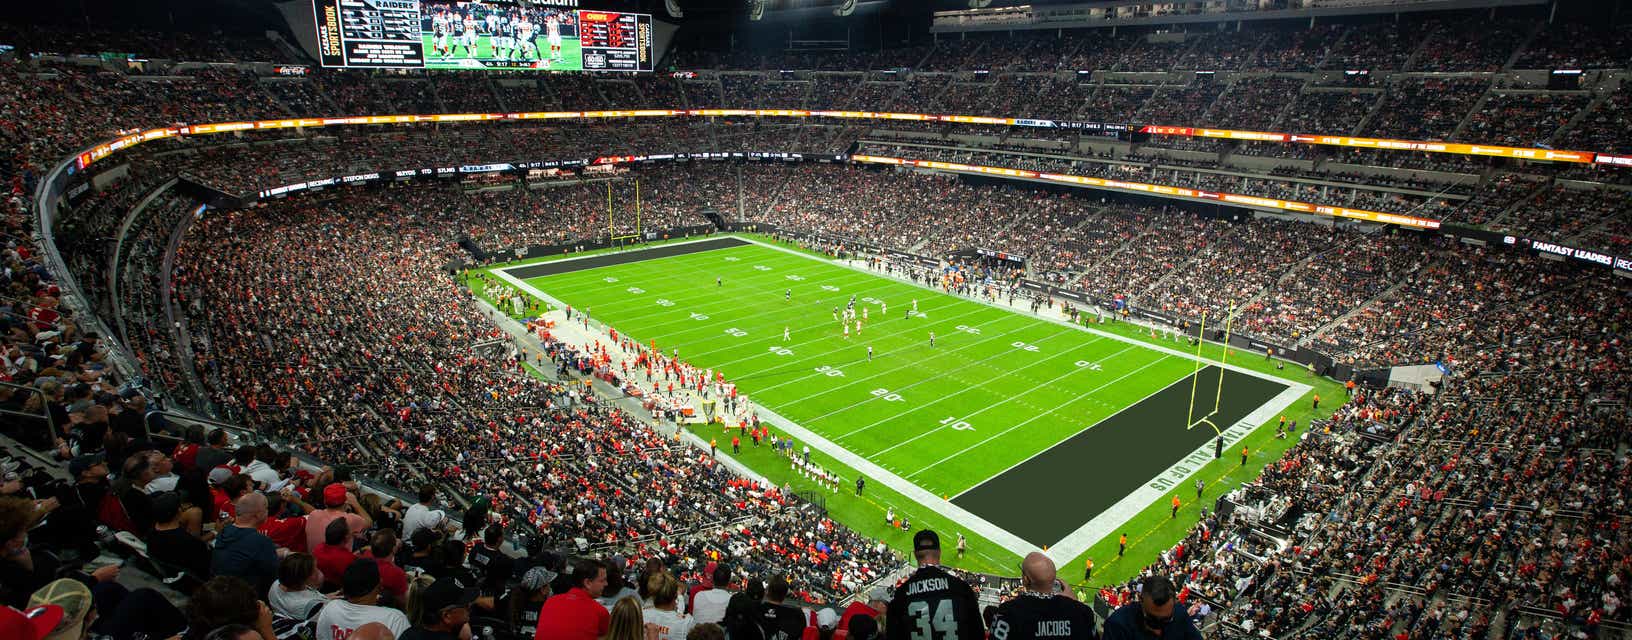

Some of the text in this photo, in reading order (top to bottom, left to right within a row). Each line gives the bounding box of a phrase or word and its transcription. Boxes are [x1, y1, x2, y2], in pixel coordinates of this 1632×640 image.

[376, 1, 414, 9] RAIDERS
[324, 5, 341, 56] SPORTSBOOK
[1532, 240, 1574, 256] FANTASY
[1574, 250, 1612, 265] LEADERS
[725, 328, 748, 337] 50
[815, 366, 841, 376] 30
[870, 388, 901, 401] 20
[940, 417, 970, 430] 10
[1237, 421, 1255, 432] IT
[1185, 450, 1212, 465] ALL
[1171, 466, 1191, 478] OF
[1150, 478, 1175, 491] US
[906, 578, 950, 596] JACKSON
[907, 599, 959, 640] 34
[1035, 620, 1072, 637] JACOBS
